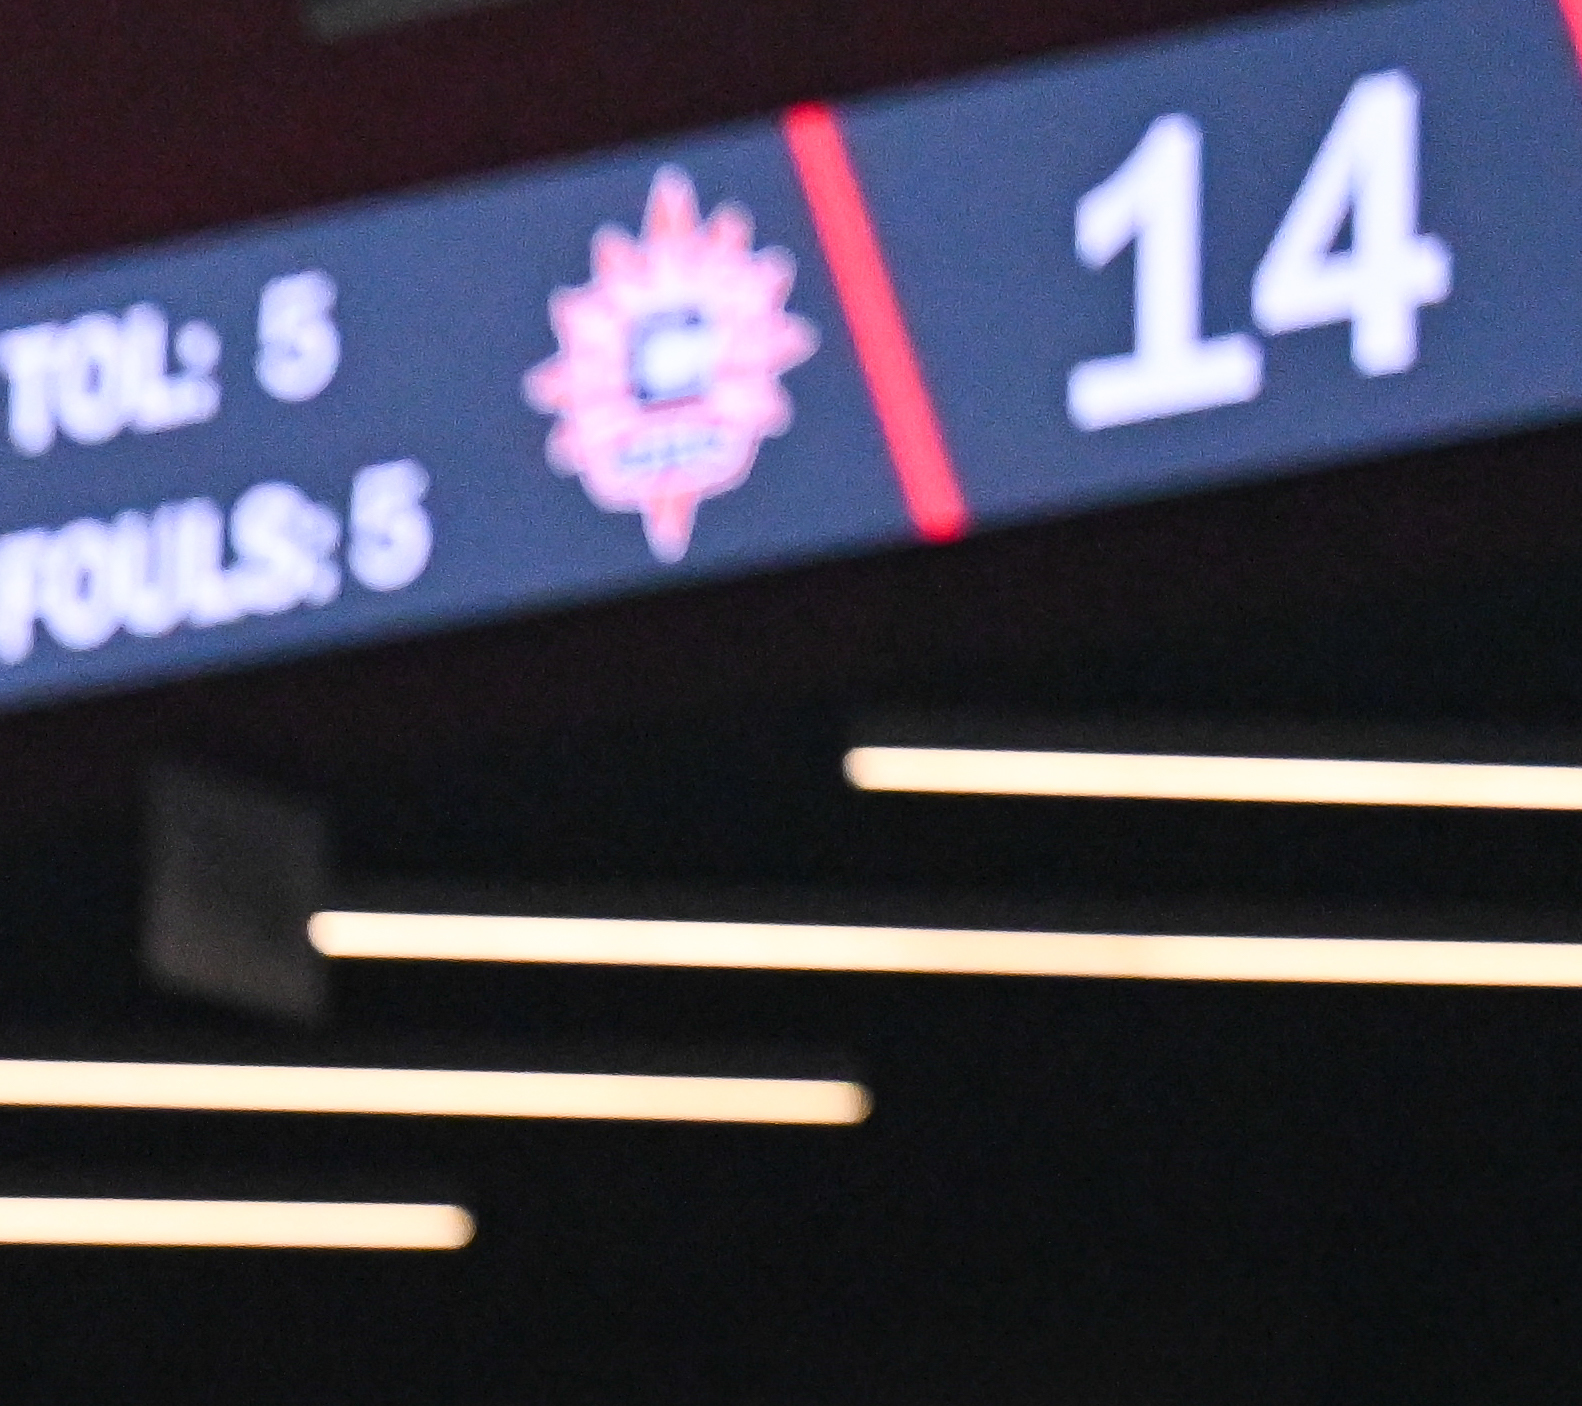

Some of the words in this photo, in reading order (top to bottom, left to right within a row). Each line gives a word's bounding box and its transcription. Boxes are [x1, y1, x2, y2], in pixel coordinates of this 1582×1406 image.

[1067, 72, 1452, 431] 14
[258, 271, 340, 401] 5
[346, 458, 433, 594] 5
